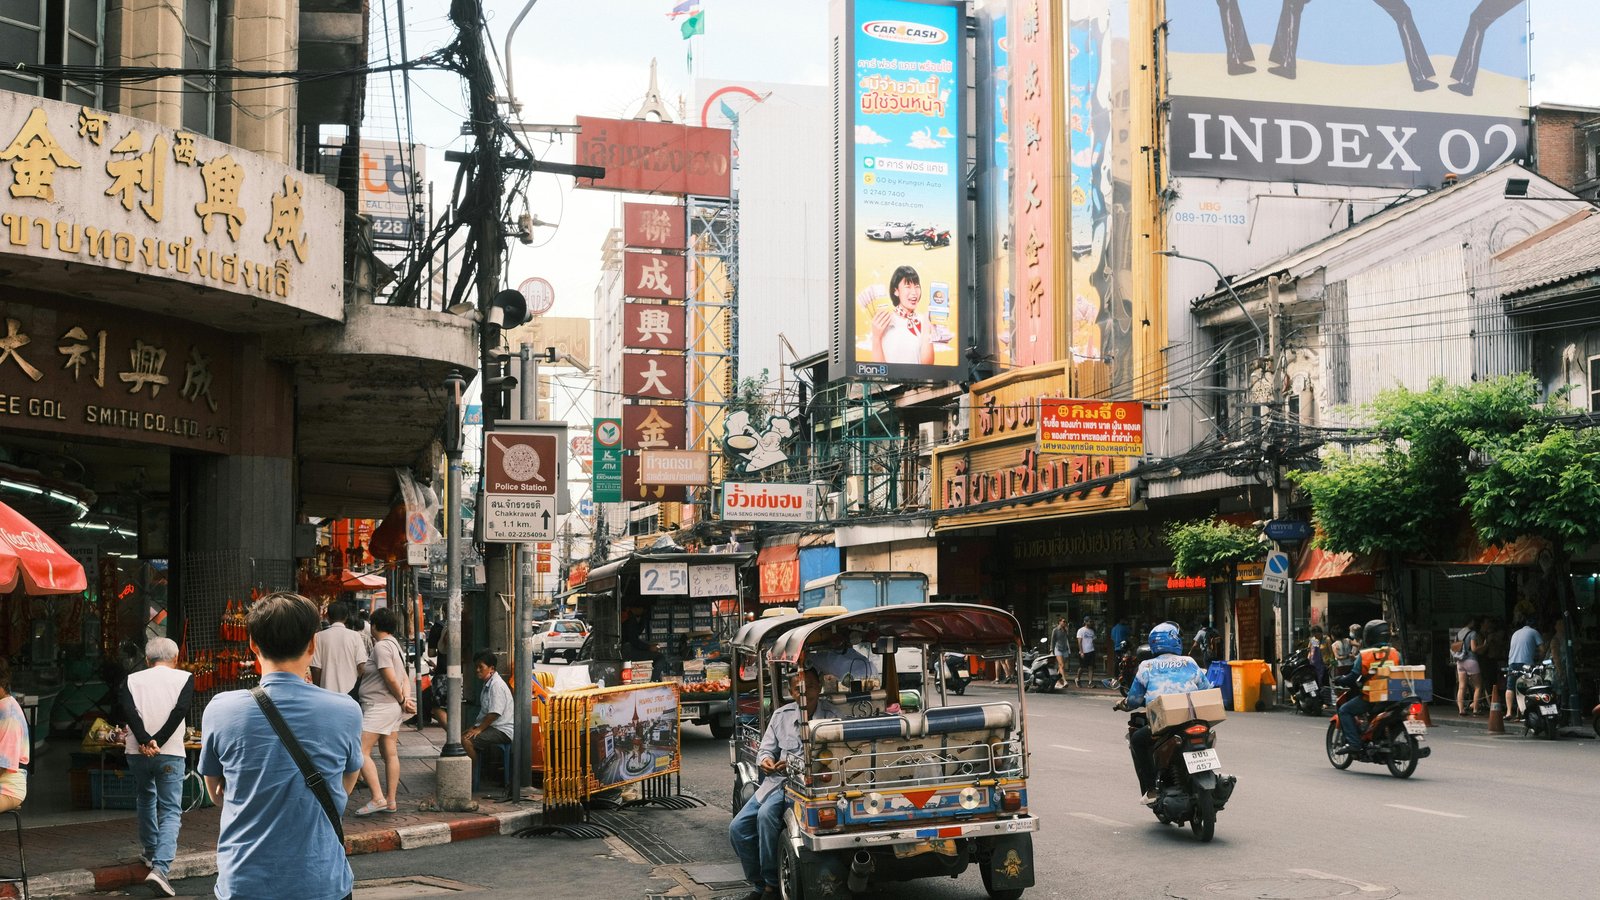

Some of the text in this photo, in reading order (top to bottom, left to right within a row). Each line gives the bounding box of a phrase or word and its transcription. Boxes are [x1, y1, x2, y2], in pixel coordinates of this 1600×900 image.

[861, 92, 942, 113] มีใช้วันหน้า
[1188, 113, 1421, 172] INDEX
[888, 190, 906, 198] 7400
[863, 199, 924, 209] www.car4cash.com
[1199, 202, 1222, 211] UBG
[1175, 212, 1246, 225] 089-170-1133
[1071, 402, 1113, 419] กิมจี้
[87, 405, 139, 428] SMITH
[495, 482, 548, 492] Police Station
[727, 484, 803, 509] ฮั้วเซ่งฮง
[491, 499, 542, 509] สน.จักรวรรดิ
[495, 510, 538, 518] Chakkrawat
[503, 520, 532, 529] 1.1 km.
[644, 568, 665, 591] 2
[1196, 762, 1212, 770] 457
